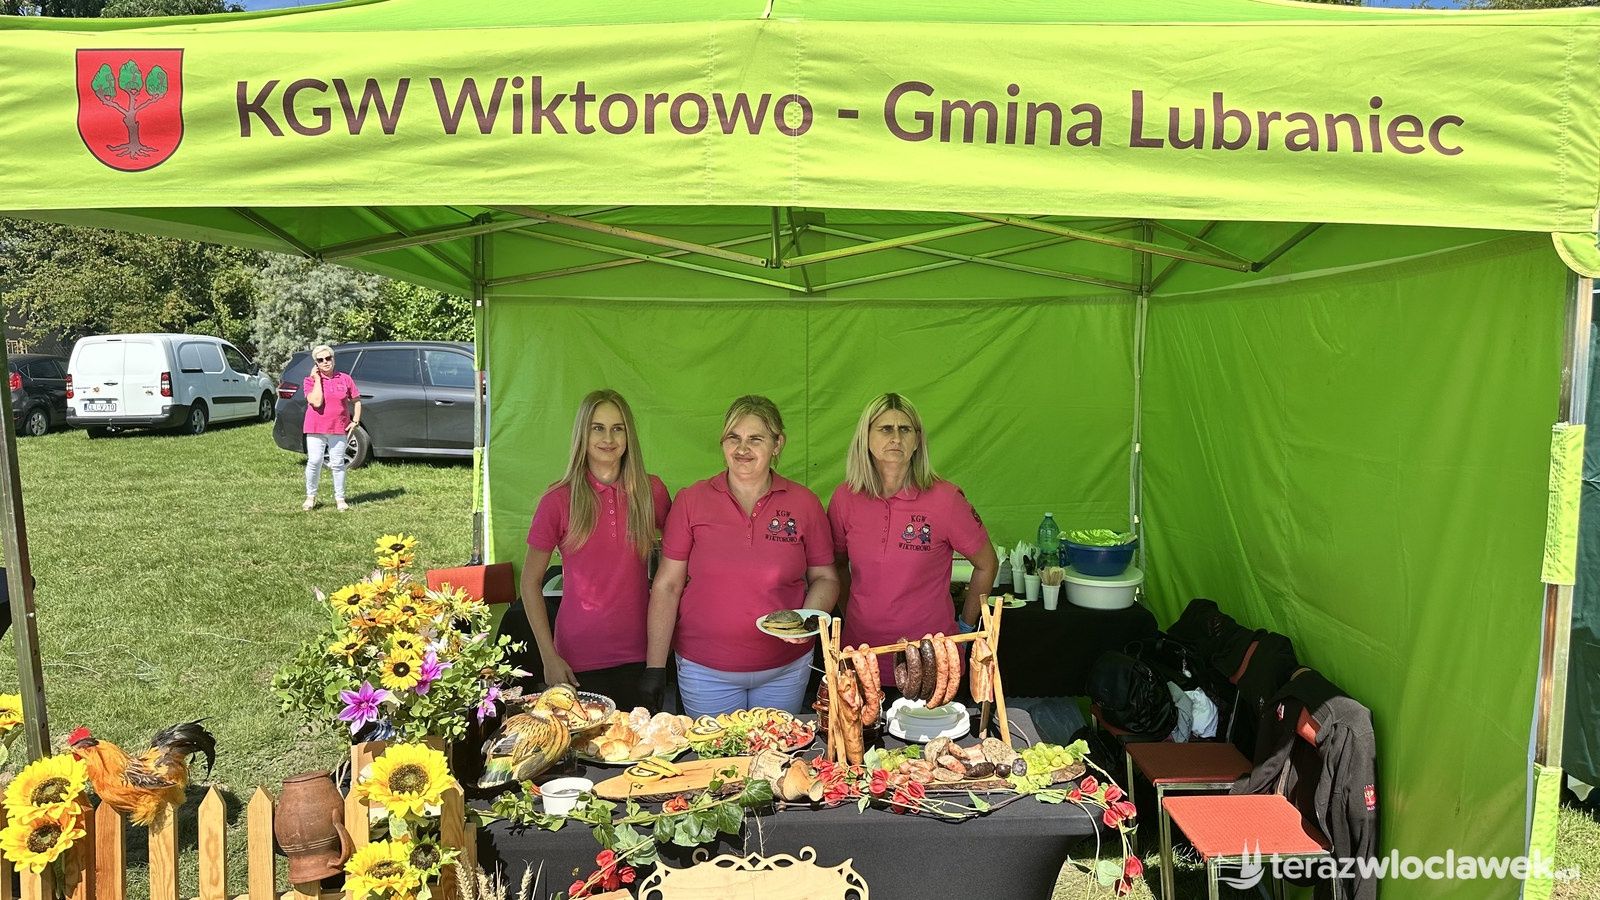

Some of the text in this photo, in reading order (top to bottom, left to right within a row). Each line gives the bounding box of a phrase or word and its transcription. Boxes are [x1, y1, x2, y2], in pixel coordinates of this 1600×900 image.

[236, 75, 1465, 156] KGW Wiktorowo - Gmina Lubraniec
[776, 509, 791, 518] KGW
[910, 514, 927, 523] KGW
